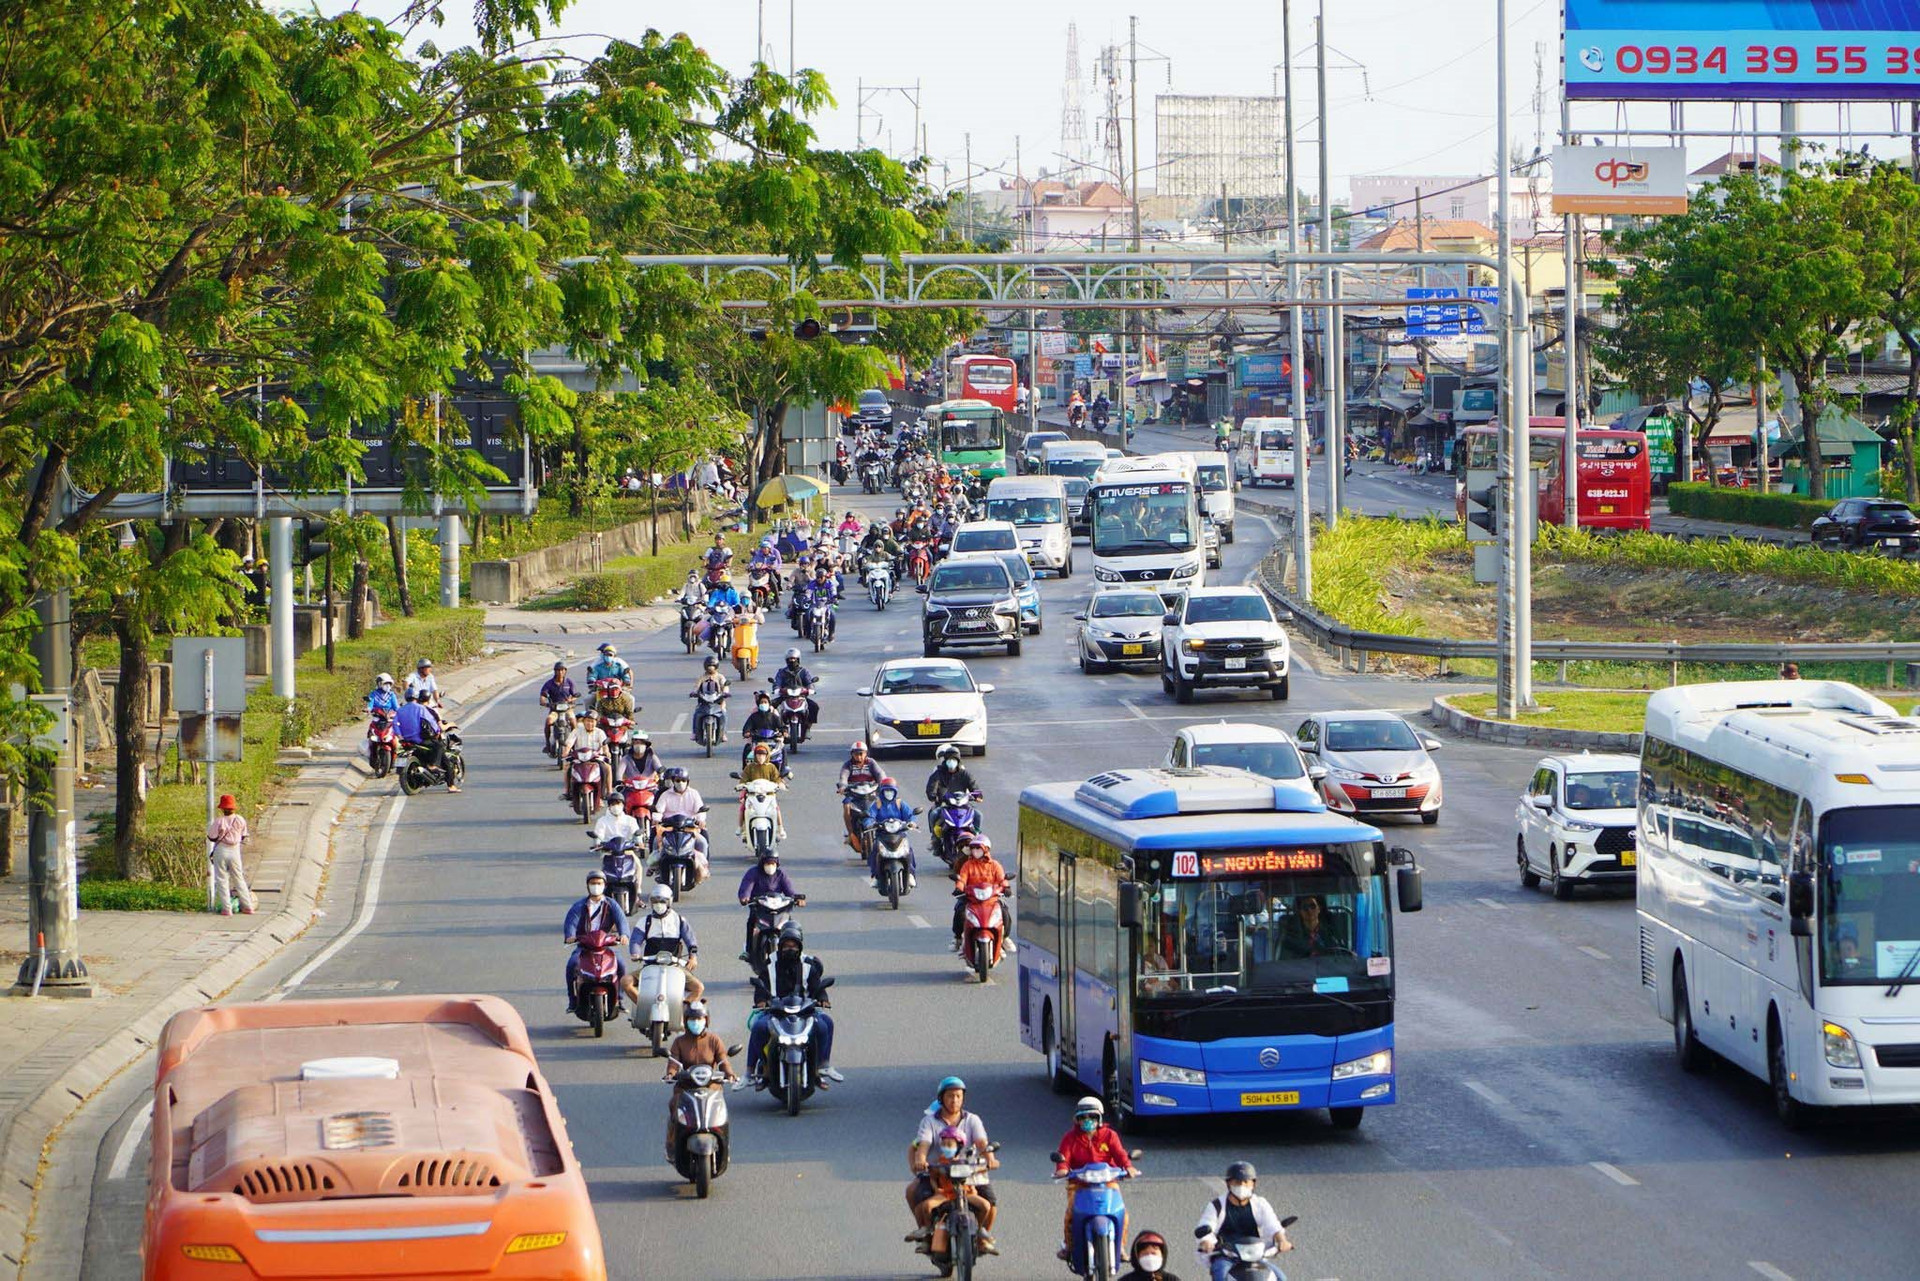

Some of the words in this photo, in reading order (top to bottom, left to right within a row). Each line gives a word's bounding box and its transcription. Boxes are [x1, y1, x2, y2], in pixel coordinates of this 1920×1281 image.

[1616, 45, 1725, 74] 0934
[1746, 46, 1797, 74] 39
[1816, 46, 1867, 74] 55
[1099, 486, 1160, 498] UNIVERSE
[1175, 854, 1196, 875] 102
[1287, 849, 1316, 870] VĂN
